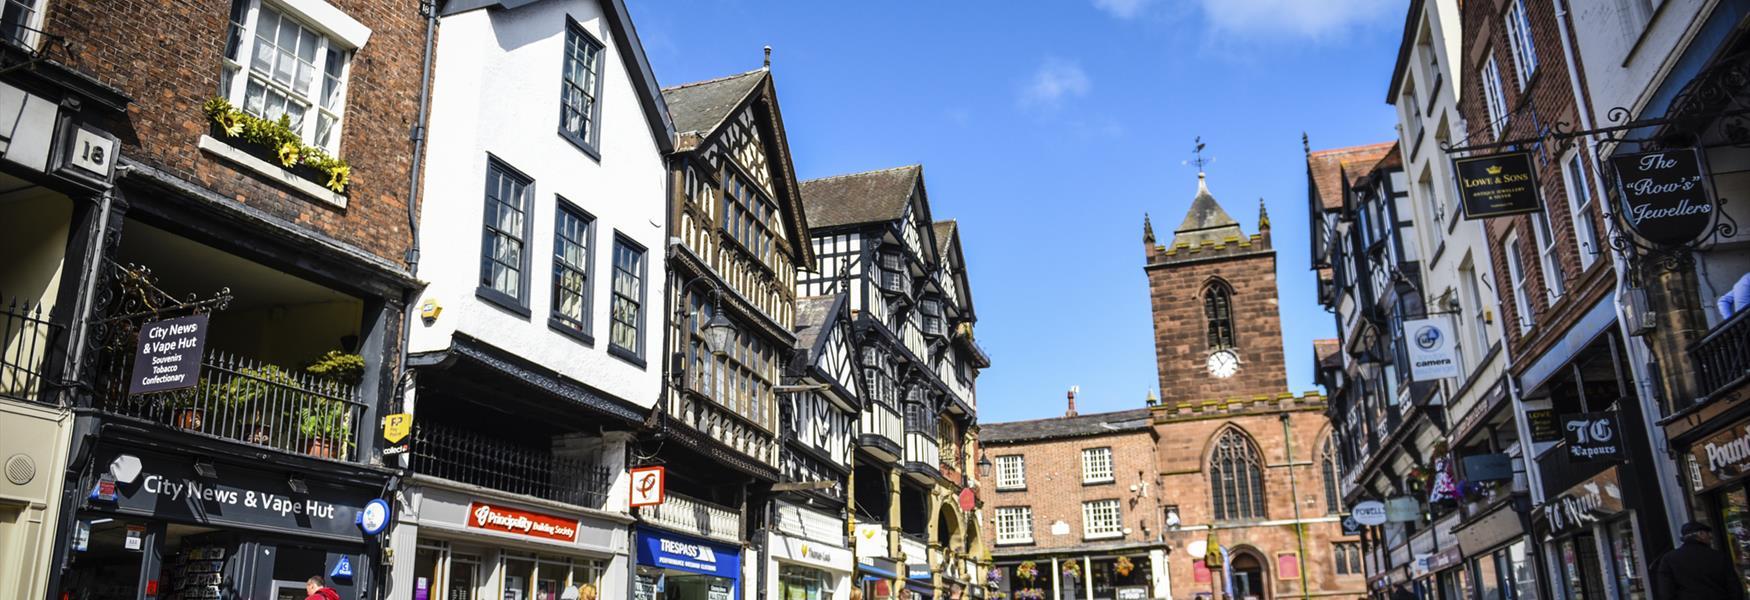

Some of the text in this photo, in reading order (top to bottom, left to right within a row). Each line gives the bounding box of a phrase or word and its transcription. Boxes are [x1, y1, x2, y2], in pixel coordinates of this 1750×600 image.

[82, 141, 104, 166] 18
[1638, 153, 1678, 171] The
[1465, 177, 1493, 188] LOWE
[1503, 173, 1528, 183] SONS
[1633, 199, 1712, 225] Jewellers
[149, 323, 198, 340] City News
[143, 336, 198, 354] & Vape Hut
[152, 353, 182, 365] Souvenirs
[1415, 358, 1451, 368] camera
[153, 364, 178, 374] Tobacco
[142, 373, 186, 386] Confectionary
[143, 475, 183, 500] City
[187, 480, 237, 504] News
[244, 490, 258, 508] &
[261, 492, 302, 517] Vape
[306, 500, 334, 519] Hut
[487, 511, 574, 537] Principality Building Society
[660, 538, 698, 557] TRESPASS
